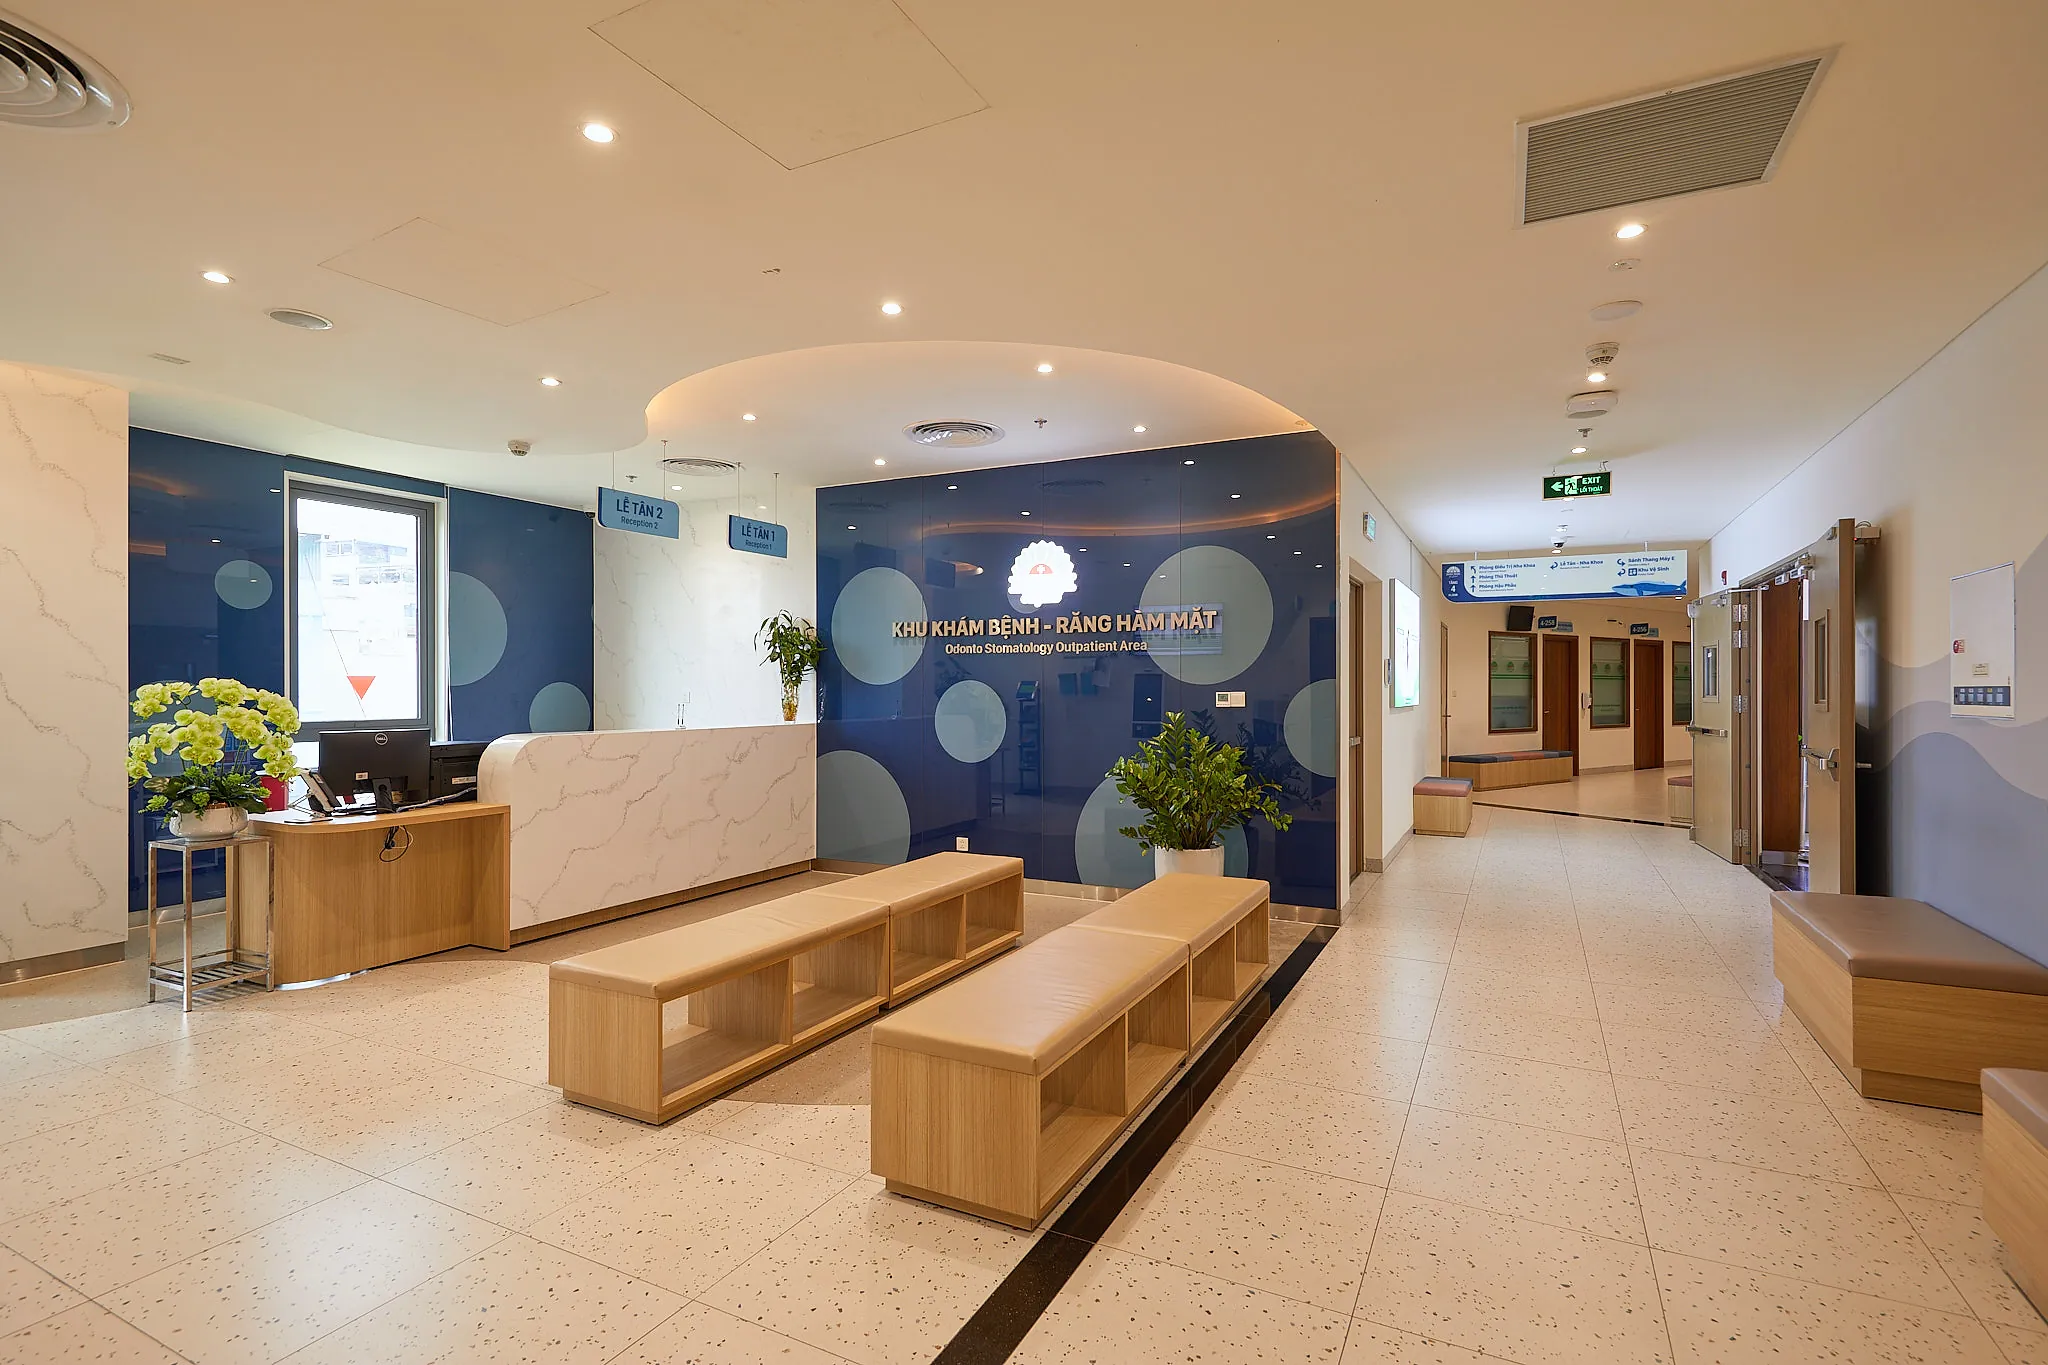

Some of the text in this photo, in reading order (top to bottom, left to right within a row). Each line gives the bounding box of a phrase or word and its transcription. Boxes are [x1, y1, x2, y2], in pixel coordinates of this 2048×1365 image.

[1582, 476, 1601, 484] EXIT
[616, 496, 664, 520] LỄ TÂN 2
[620, 516, 652, 528] Reception
[741, 522, 776, 542] LỄ TÂN 1
[745, 540, 768, 550] Reception
[892, 621, 928, 638] KHU
[932, 616, 984, 636] KHÁM
[988, 614, 1040, 640] BỆNH
[1056, 611, 1112, 634] RĂNG
[1116, 609, 1165, 632] HÀM
[1171, 606, 1218, 634] MẶT
[946, 640, 1148, 656] Odonto Stomatology Outpatient Area
